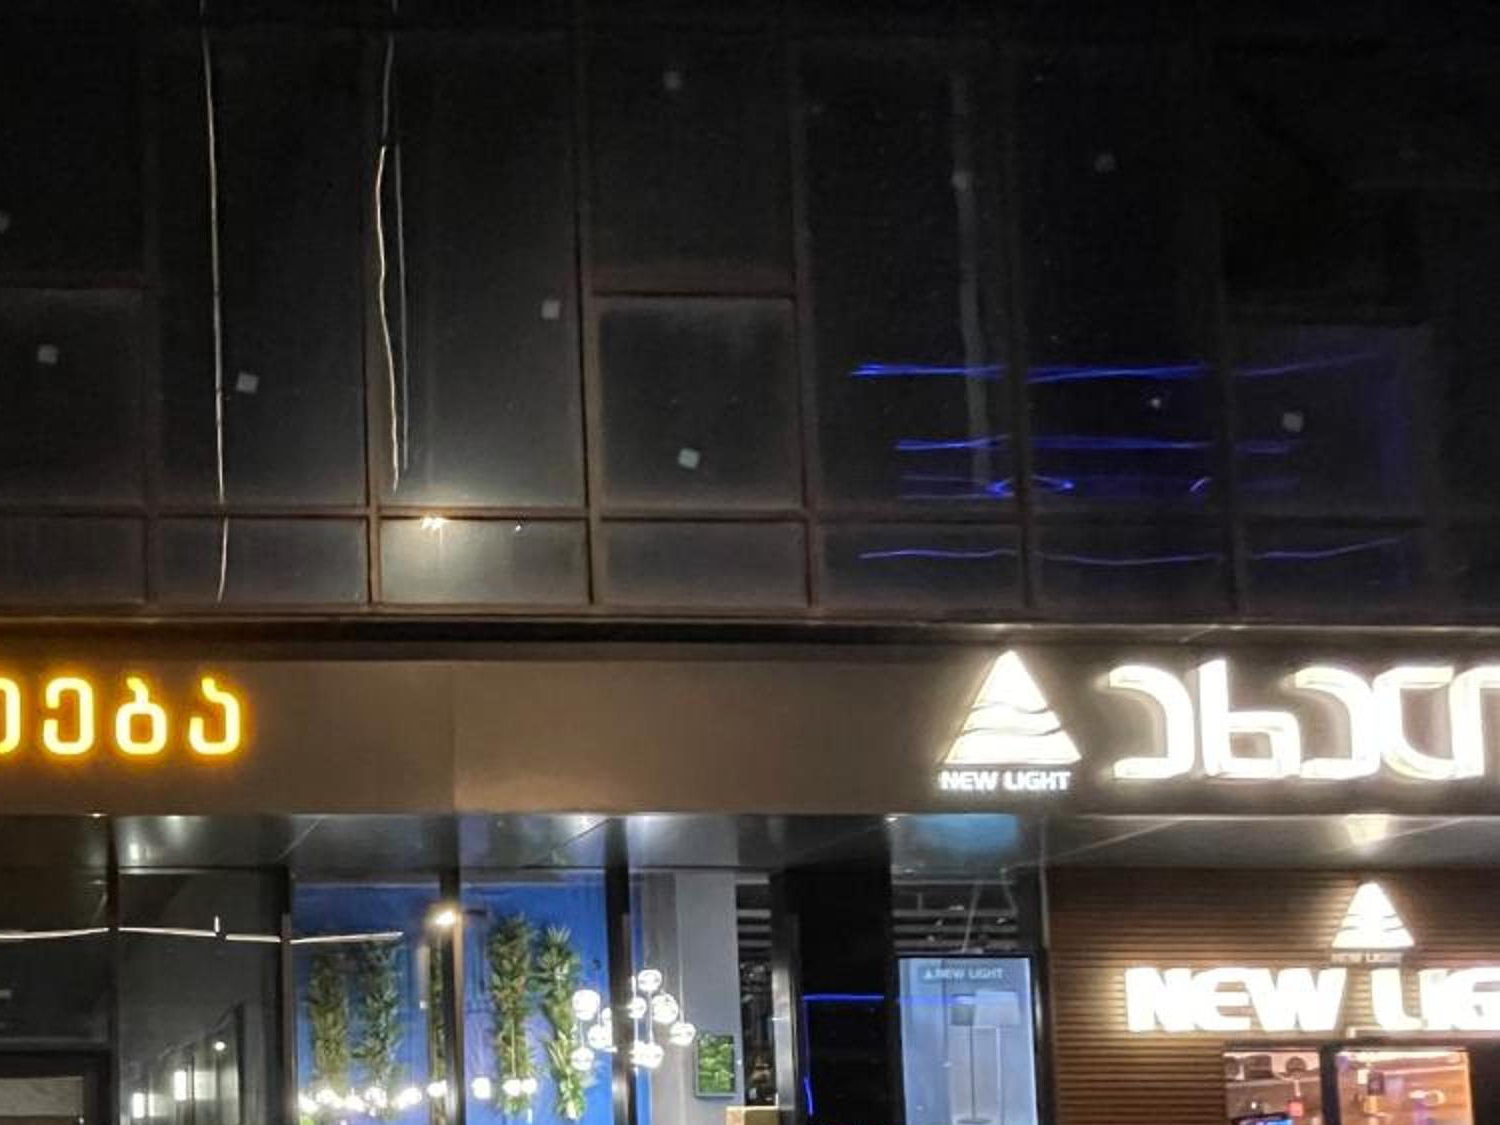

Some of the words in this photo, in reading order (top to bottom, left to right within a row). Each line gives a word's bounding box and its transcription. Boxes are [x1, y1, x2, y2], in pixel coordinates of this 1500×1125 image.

[938, 770, 998, 792] NEW
[1002, 770, 1071, 792] LIGHT
[1125, 967, 1346, 1032] NEW
